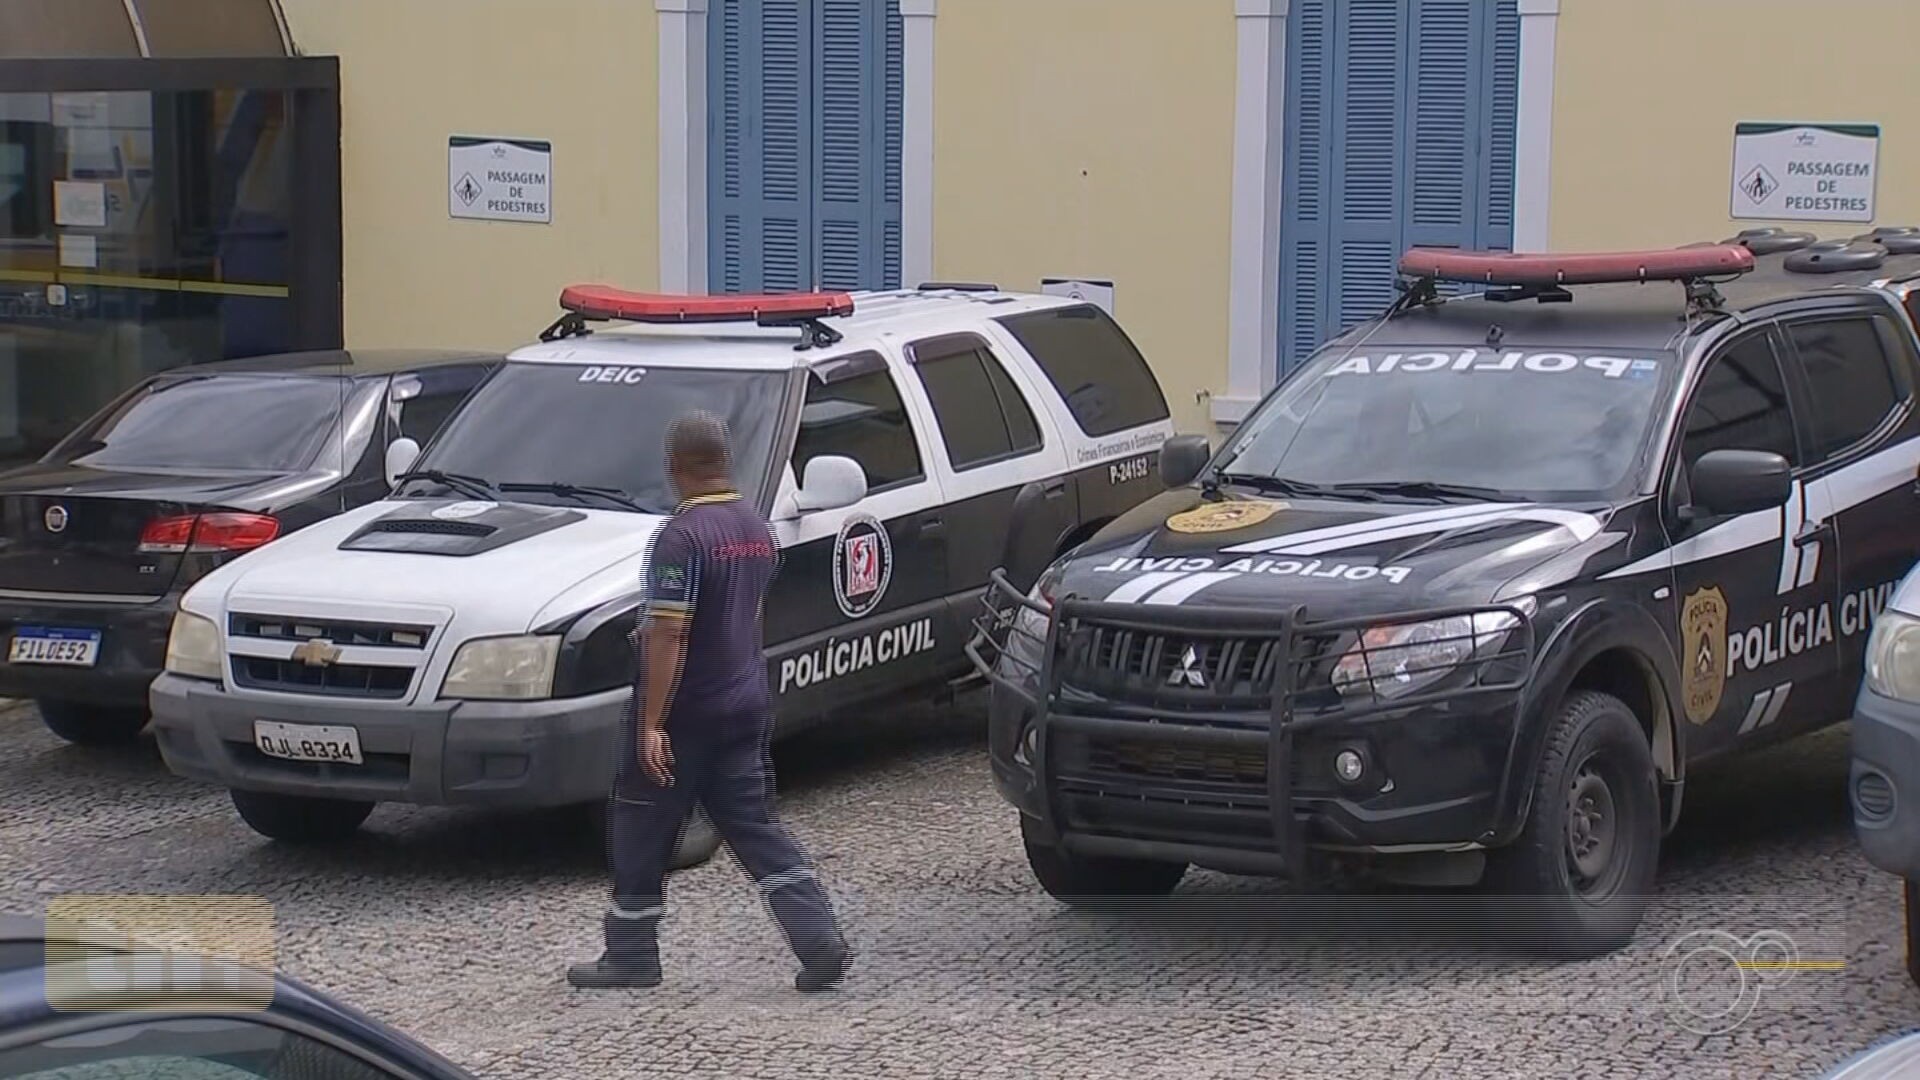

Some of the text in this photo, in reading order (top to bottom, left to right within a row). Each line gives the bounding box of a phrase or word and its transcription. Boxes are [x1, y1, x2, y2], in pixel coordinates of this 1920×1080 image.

[1787, 161, 1870, 177] PASSAGEM
[487, 171, 546, 185] PASSAGEM
[509, 187, 523, 198] DE
[1816, 180, 1837, 193] DE
[487, 200, 546, 214] PEDESTRES
[1785, 196, 1868, 211] PEDESTRES
[578, 366, 647, 384] DEIC
[1109, 457, 1148, 485] P-24152
[1726, 580, 1901, 678] POLÍCIA CIV
[779, 636, 874, 694] POLÍCIA
[876, 618, 936, 663] CIVIL
